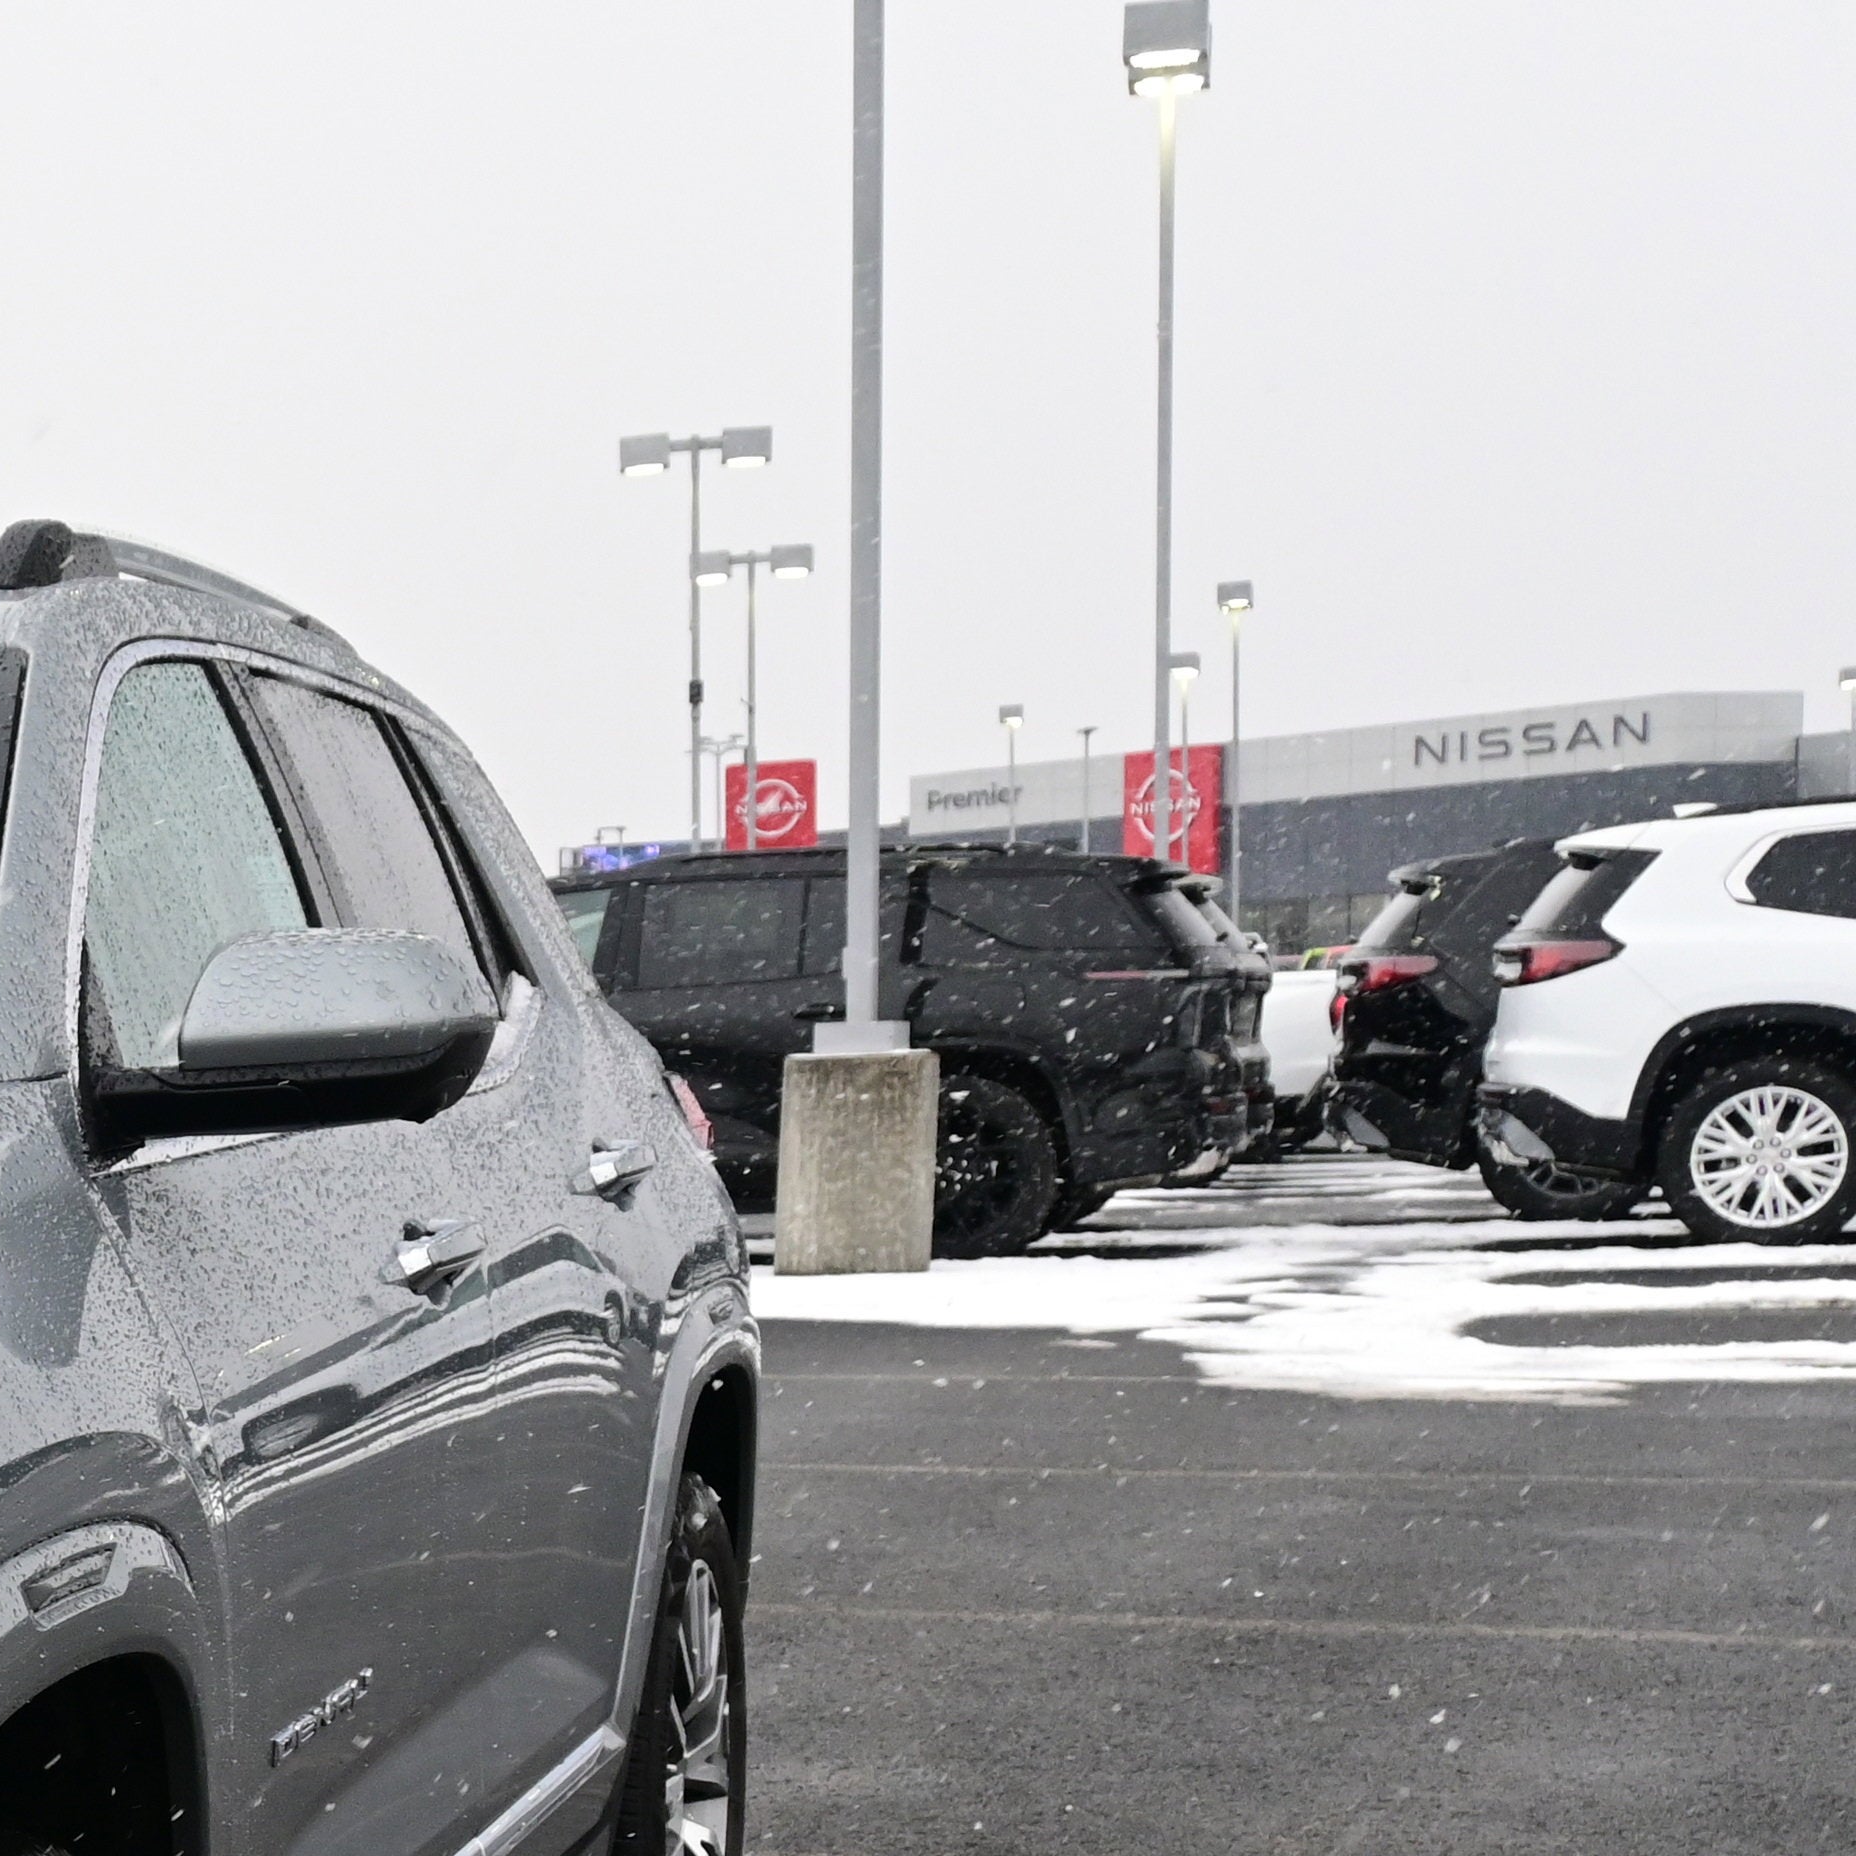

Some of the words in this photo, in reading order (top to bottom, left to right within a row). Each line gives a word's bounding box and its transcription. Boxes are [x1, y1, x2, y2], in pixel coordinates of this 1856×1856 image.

[1414, 711, 1650, 766] NISSAN
[735, 800, 808, 815] NAN
[928, 782, 1023, 811] Premier
[1131, 797, 1201, 814] NIAN
